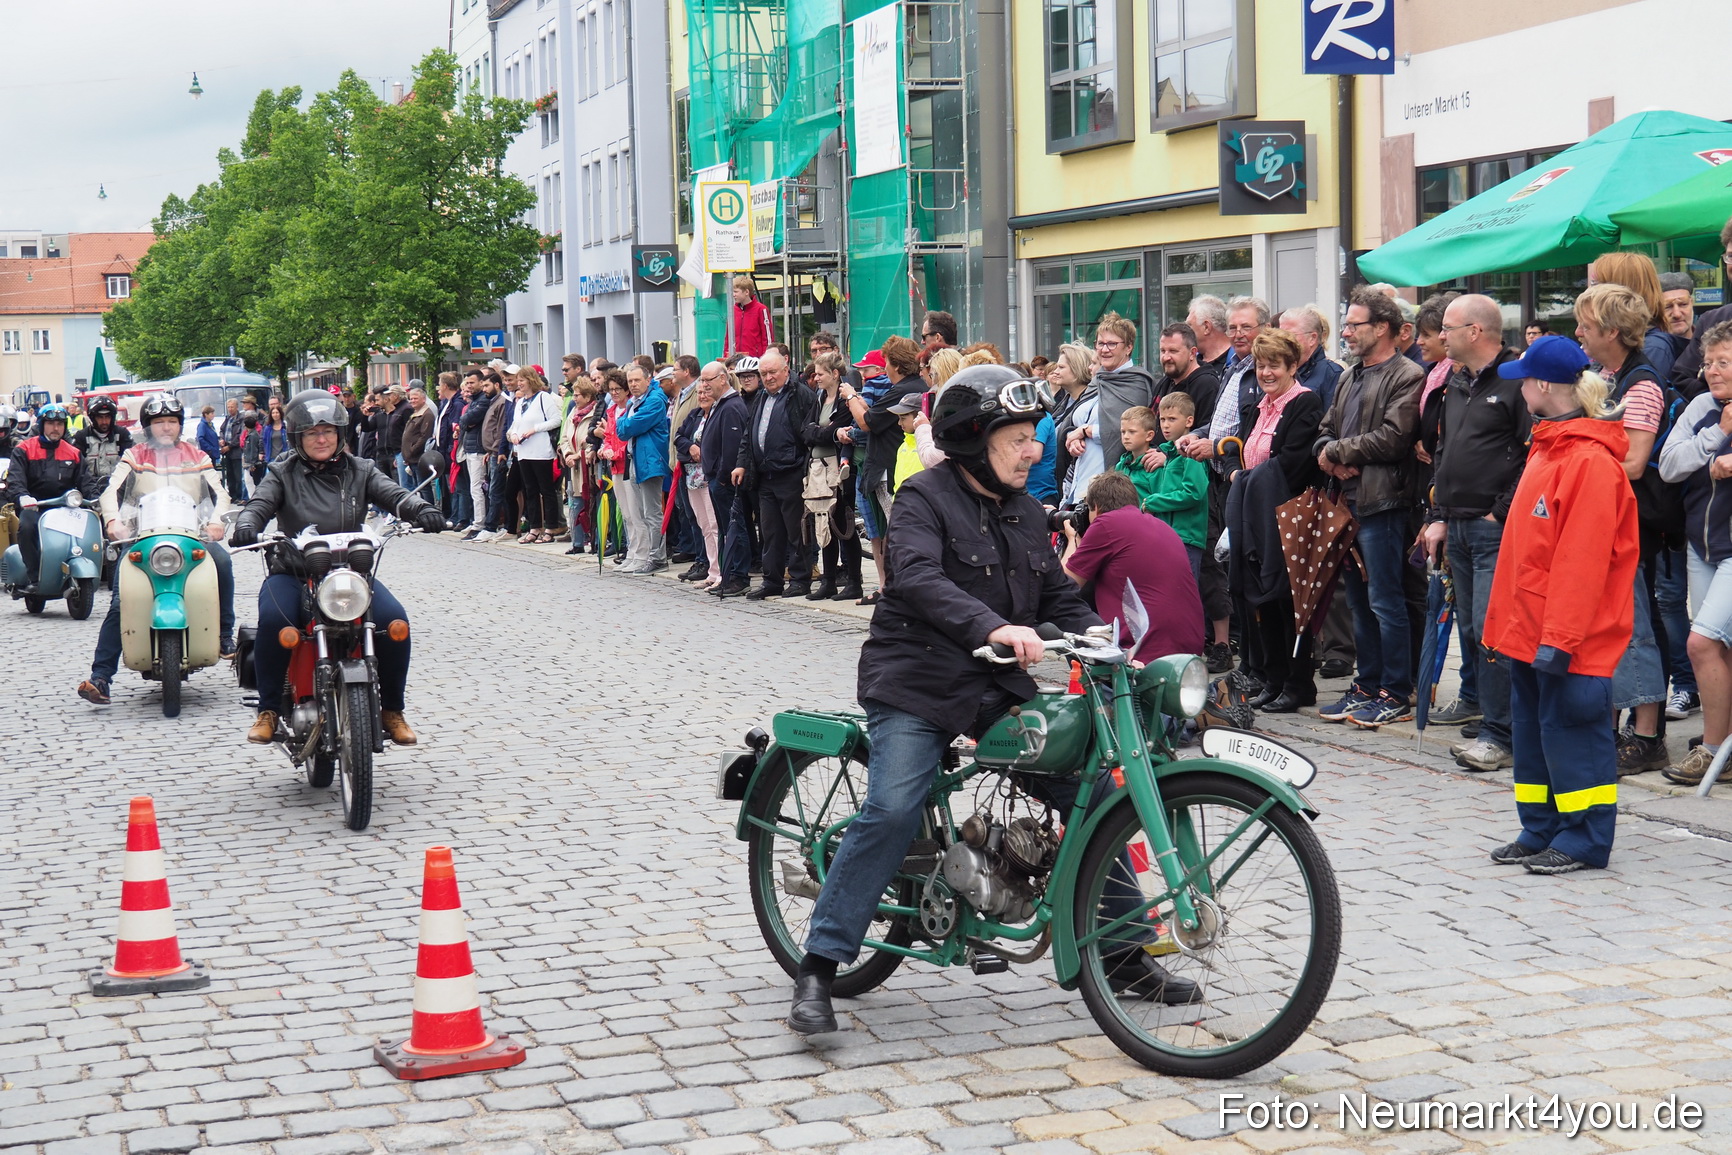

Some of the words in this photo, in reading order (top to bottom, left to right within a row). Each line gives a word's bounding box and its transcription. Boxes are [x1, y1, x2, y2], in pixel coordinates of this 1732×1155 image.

[1404, 102, 1433, 121] Unterer
[1435, 95, 1459, 114] Markt
[1461, 91, 1471, 109] 15
[1255, 145, 1285, 184] G2
[718, 196, 734, 217] H
[648, 257, 665, 277] G2
[168, 494, 187, 504] 545
[792, 728, 824, 740] WANDERER
[989, 739, 1018, 747] WANDERER
